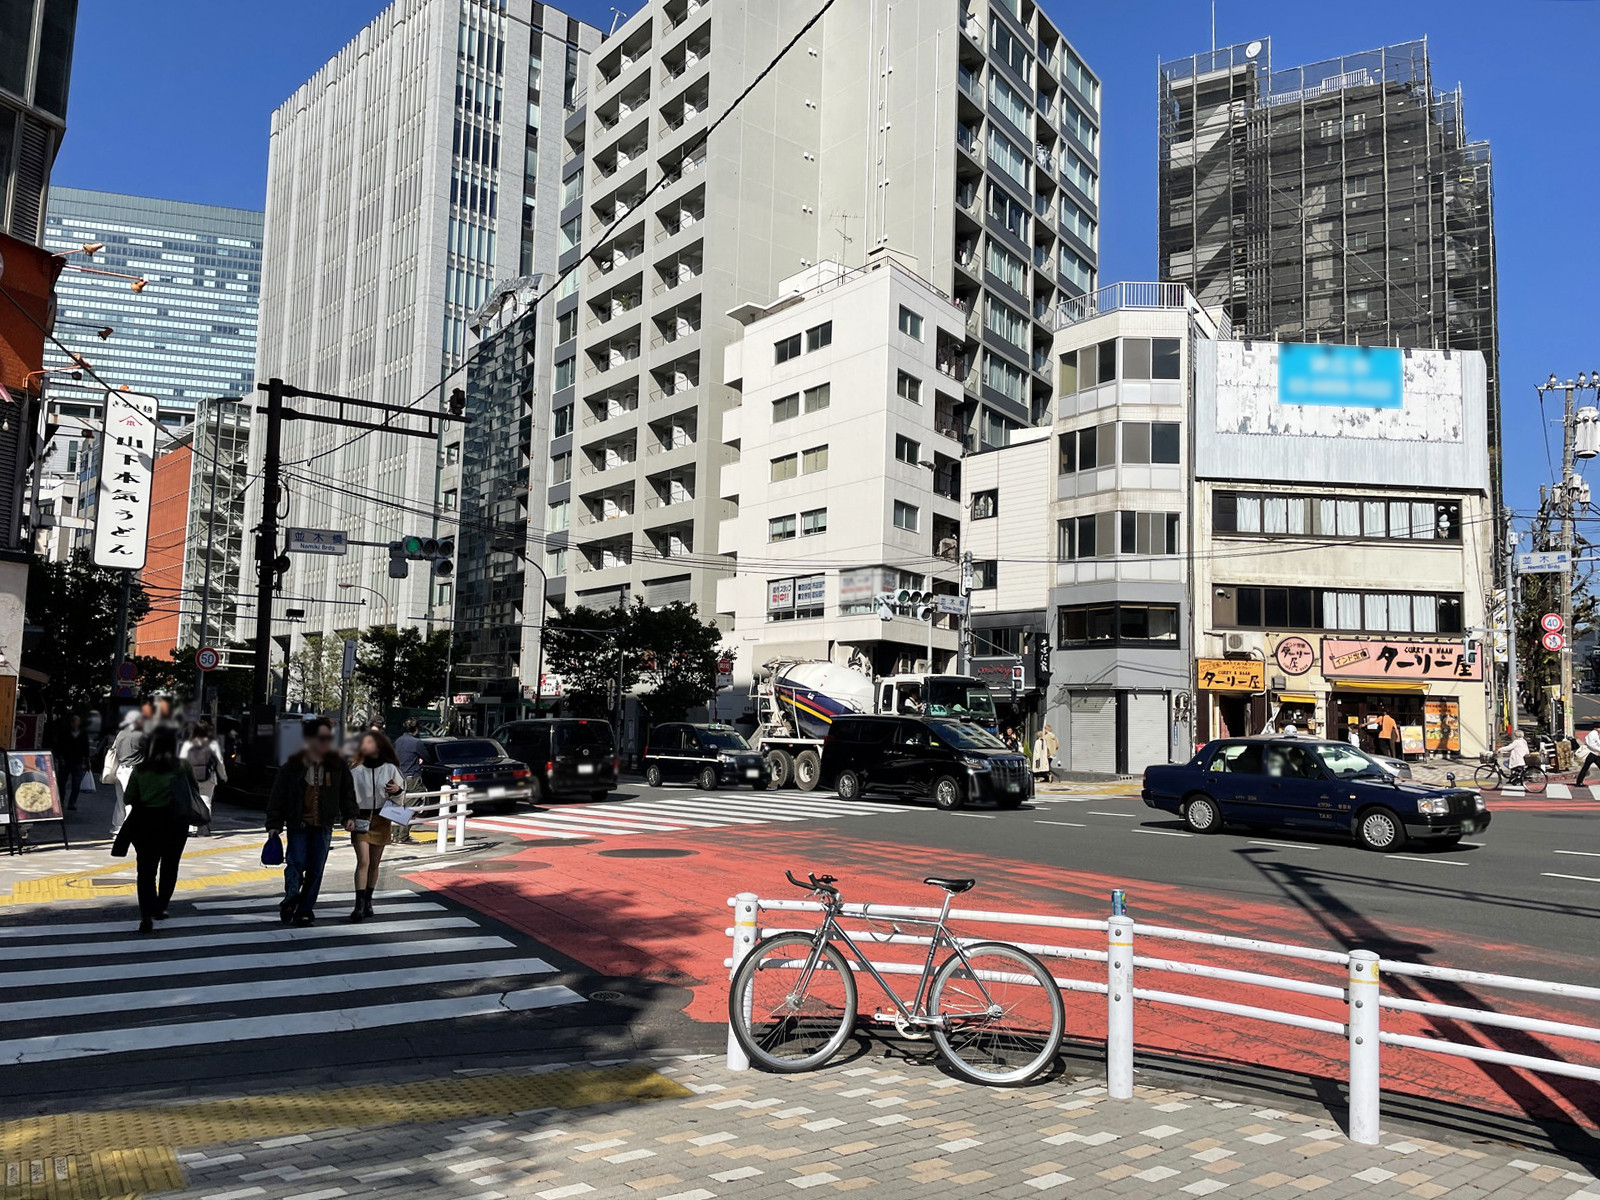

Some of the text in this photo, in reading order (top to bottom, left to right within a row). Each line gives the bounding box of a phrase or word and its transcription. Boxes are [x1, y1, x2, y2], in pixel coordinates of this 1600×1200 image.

[108, 436, 144, 556] 山下本気うどん
[294, 531, 343, 545] 並木橋
[300, 542, 320, 550] Namiki
[1522, 554, 1567, 565] 並木橋
[1546, 618, 1559, 628] 40
[1404, 646, 1425, 654] CURRY
[1436, 647, 1453, 655] NAAN
[201, 653, 214, 665] 50
[1377, 645, 1472, 677] ターリー屋
[1202, 671, 1260, 689] ターリー屋
